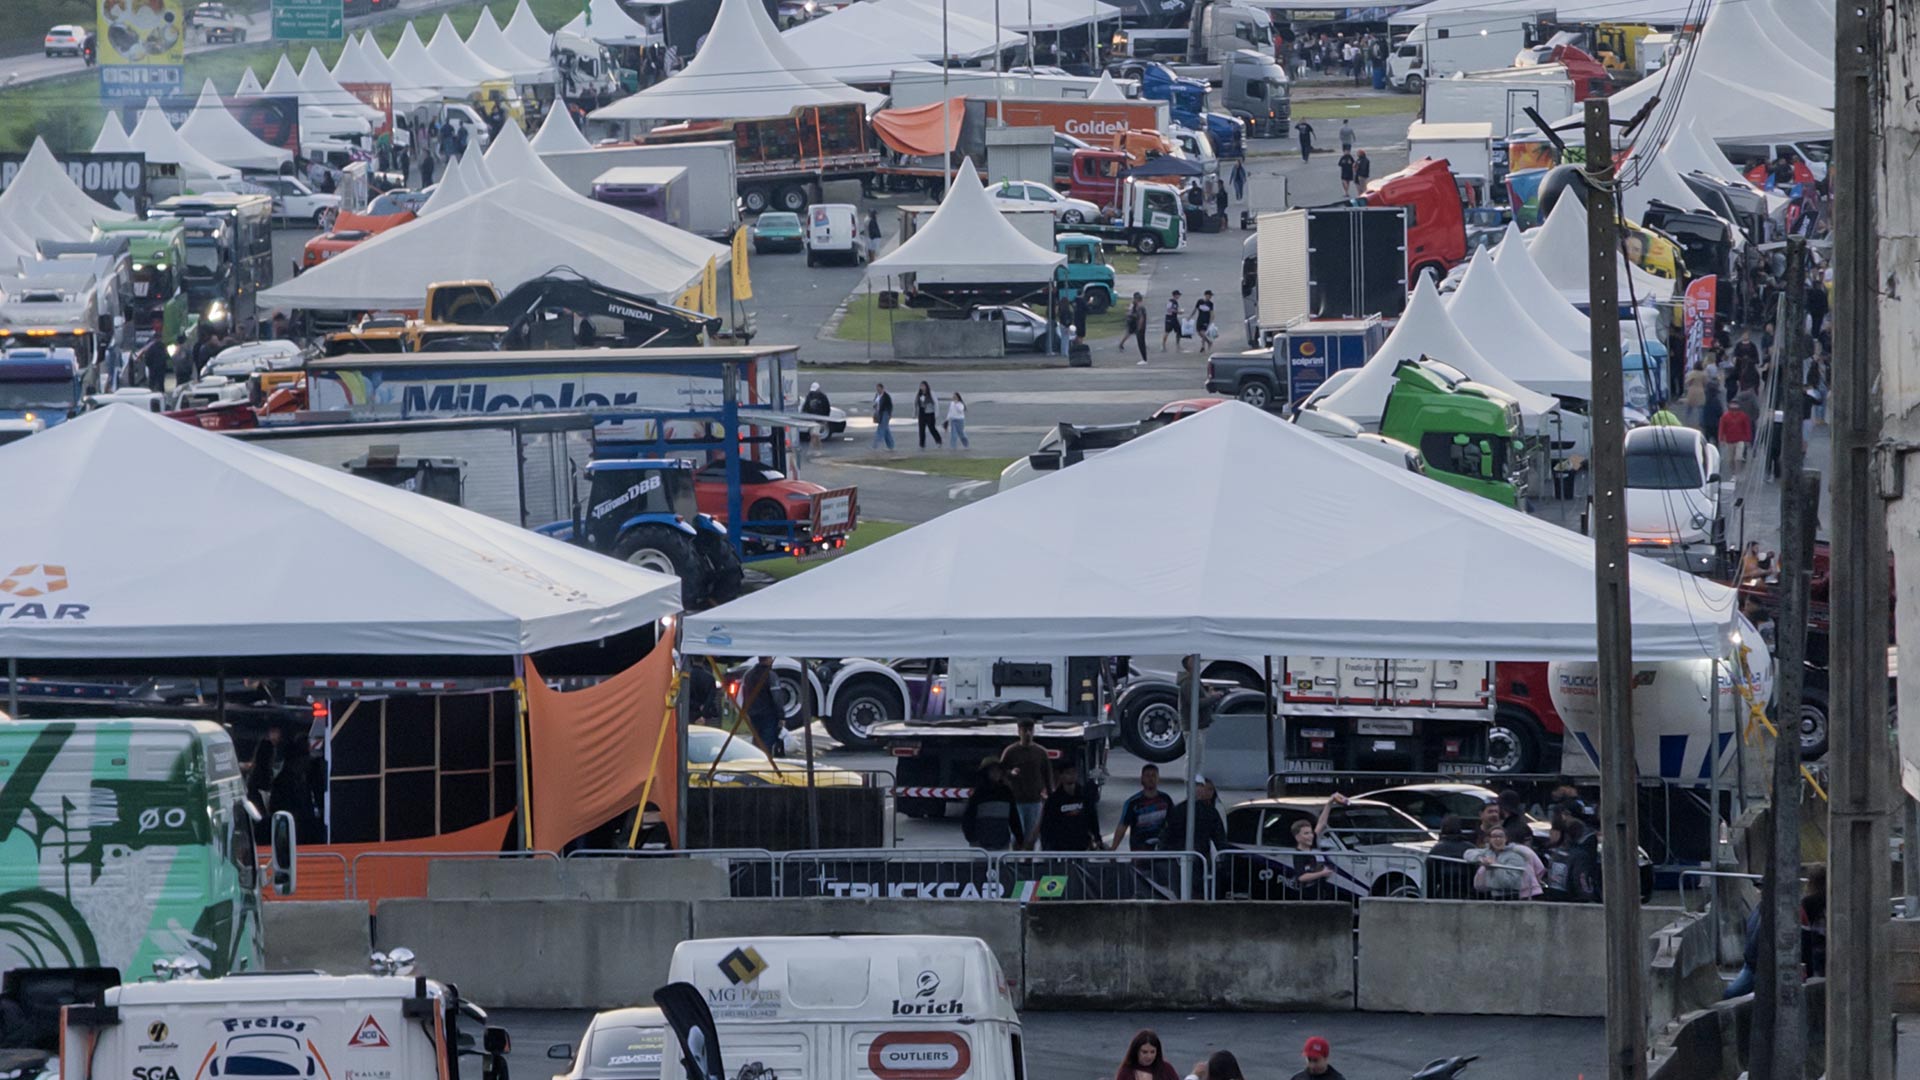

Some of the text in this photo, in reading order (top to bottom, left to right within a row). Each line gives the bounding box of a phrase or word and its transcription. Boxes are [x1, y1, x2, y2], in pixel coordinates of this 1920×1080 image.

[608, 304, 653, 321] HYUNDAI
[1292, 357, 1324, 367] solprint
[627, 475, 661, 500] DBB
[827, 882, 1004, 899] TRUCKCAR
[709, 988, 736, 1001] MG
[892, 999, 963, 1015] lorich
[222, 1016, 306, 1033] Freios
[359, 1031, 378, 1040] JCG
[889, 1051, 949, 1061] OUTLIERS
